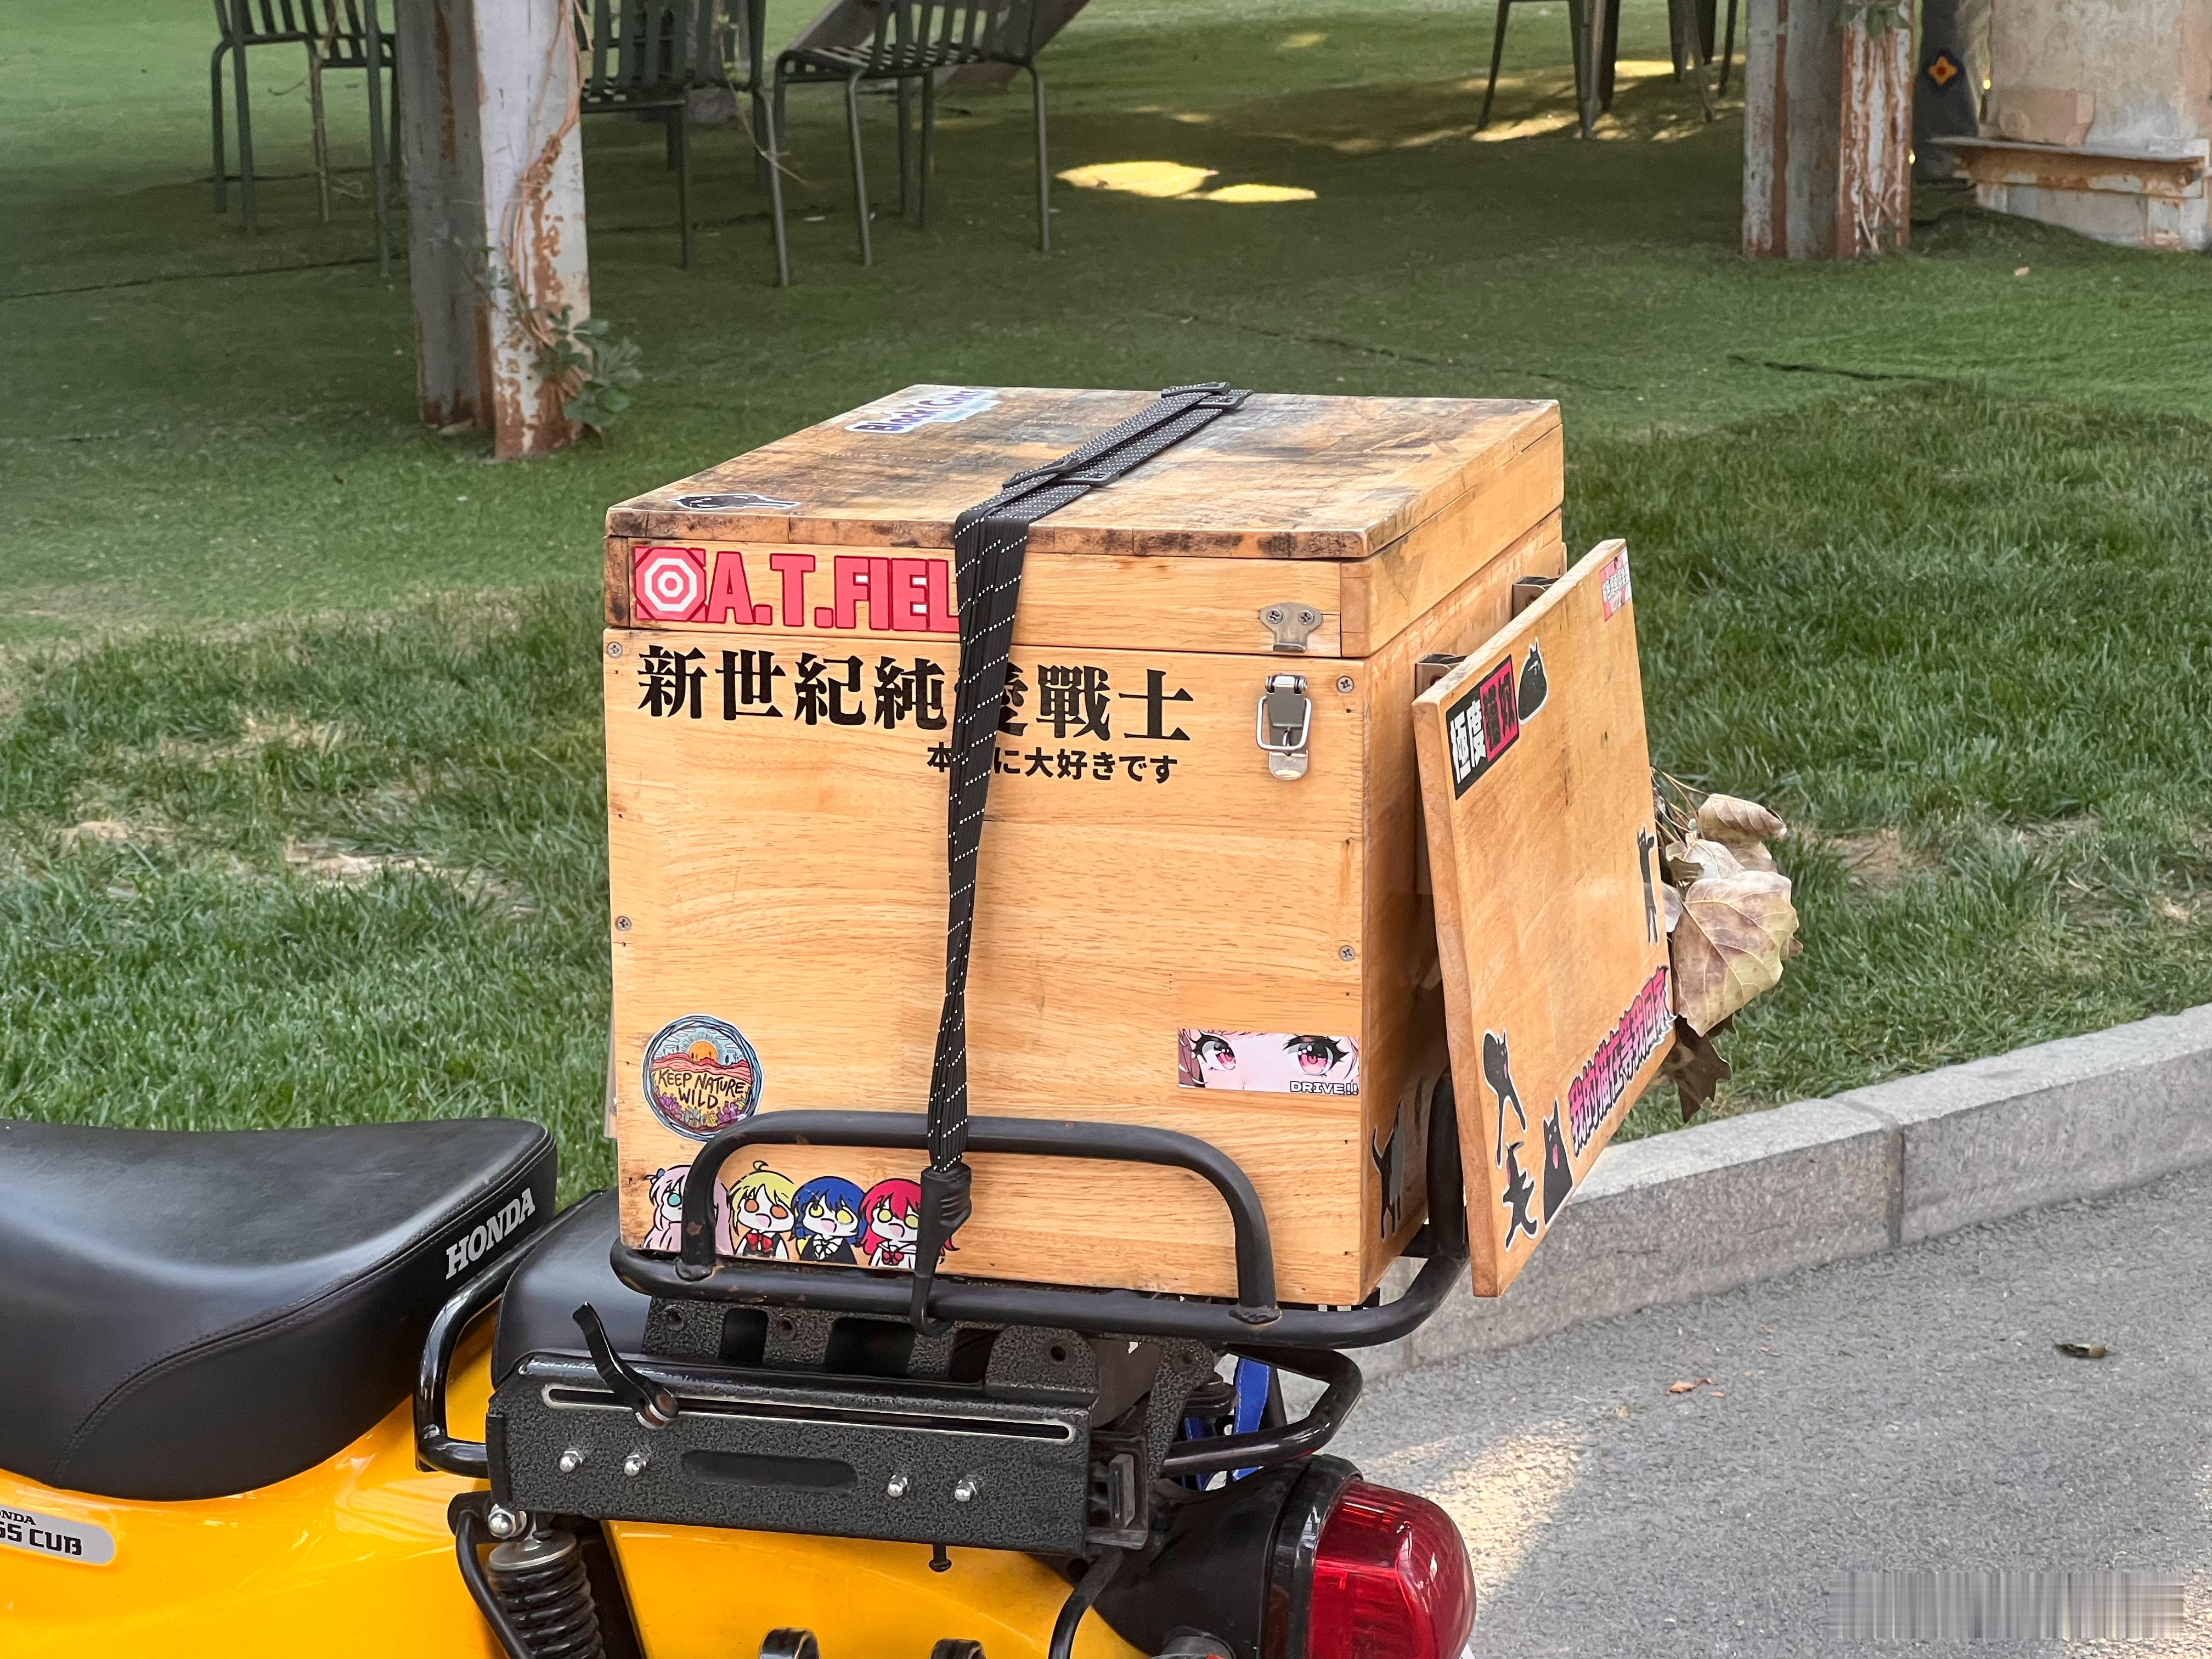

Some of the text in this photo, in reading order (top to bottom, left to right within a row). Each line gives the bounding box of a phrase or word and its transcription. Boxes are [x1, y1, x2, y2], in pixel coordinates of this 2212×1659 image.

[706, 551, 960, 633] A.T.FIEL
[927, 742, 1178, 784] 本に大好きです
[658, 1069, 746, 1098] KEEP NATURE
[678, 1088, 719, 1109] WILD
[445, 1187, 535, 1280] HONDA
[0, 1510, 36, 1526] NDA
[29, 1528, 82, 1556] CUB
